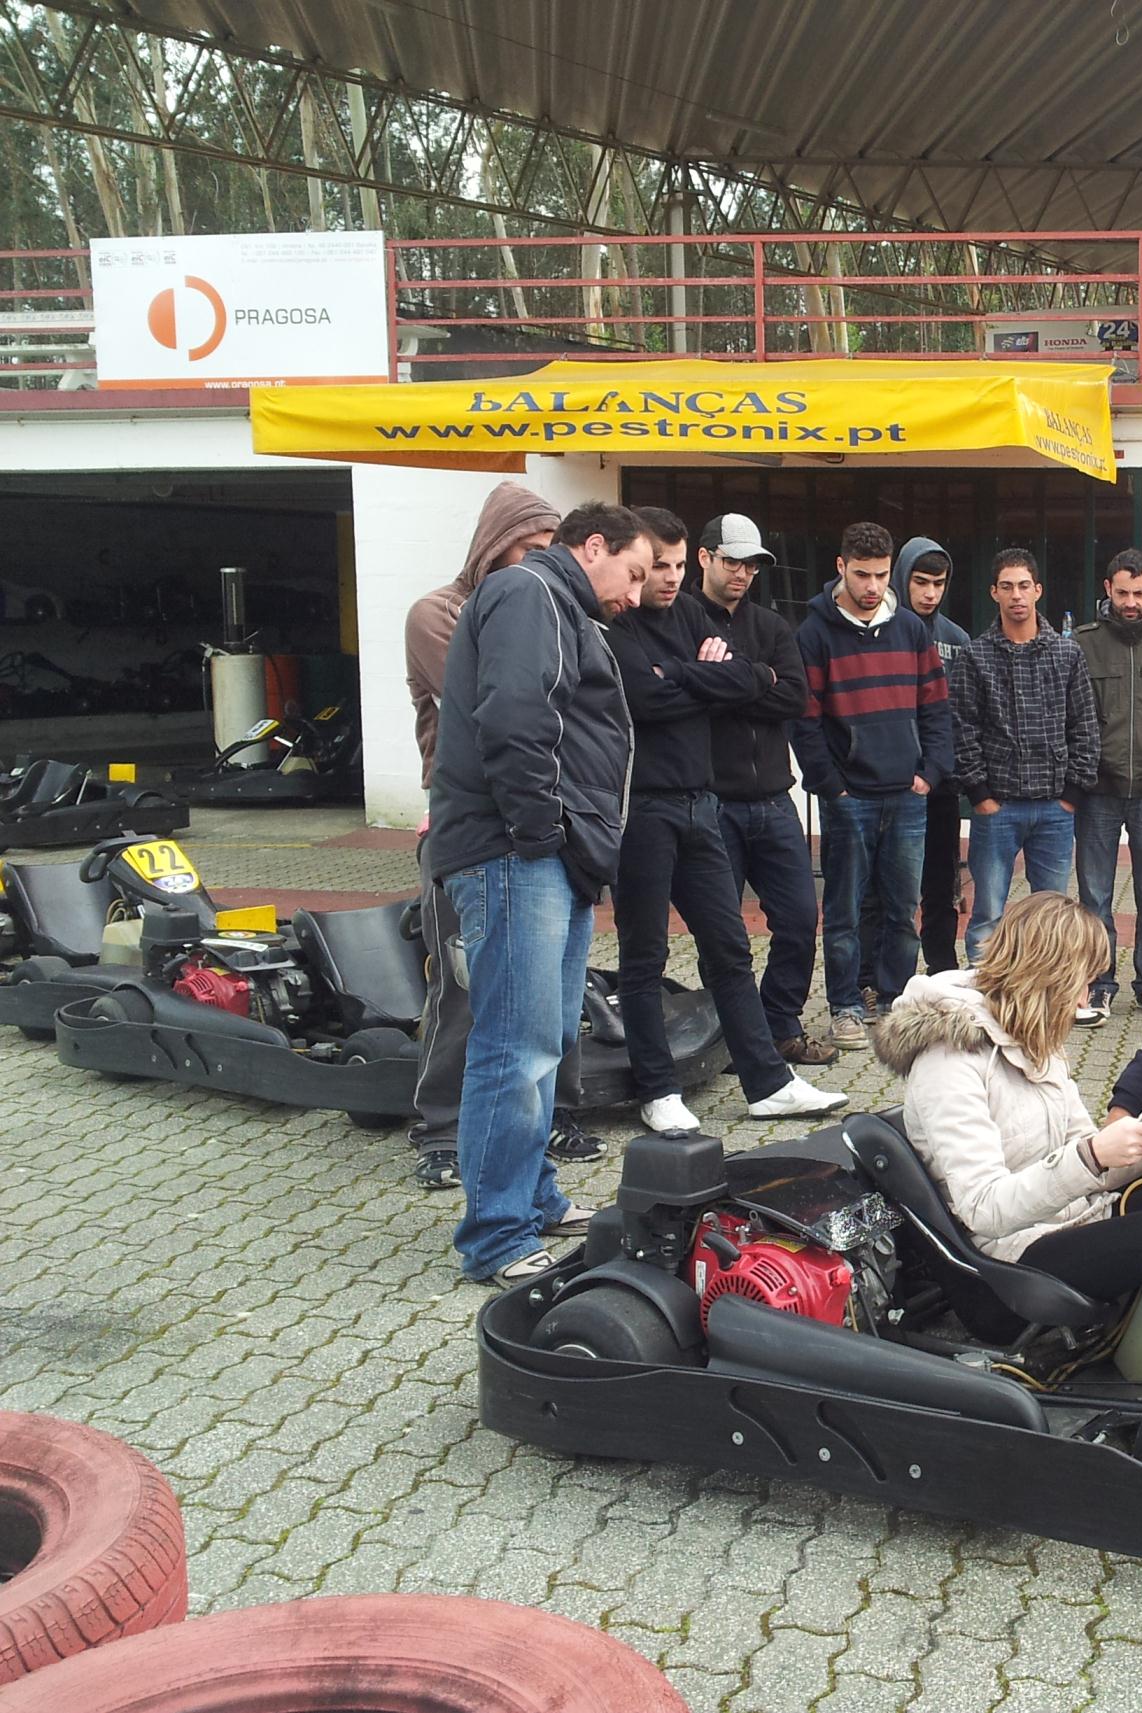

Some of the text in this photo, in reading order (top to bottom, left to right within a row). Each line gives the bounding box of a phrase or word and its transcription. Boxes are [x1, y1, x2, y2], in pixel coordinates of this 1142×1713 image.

[234, 307, 332, 326] PRAGOSA
[1043, 338, 1088, 347] HONDA
[374, 418, 907, 447] www.pestronix.pt
[137, 845, 184, 874] 22
